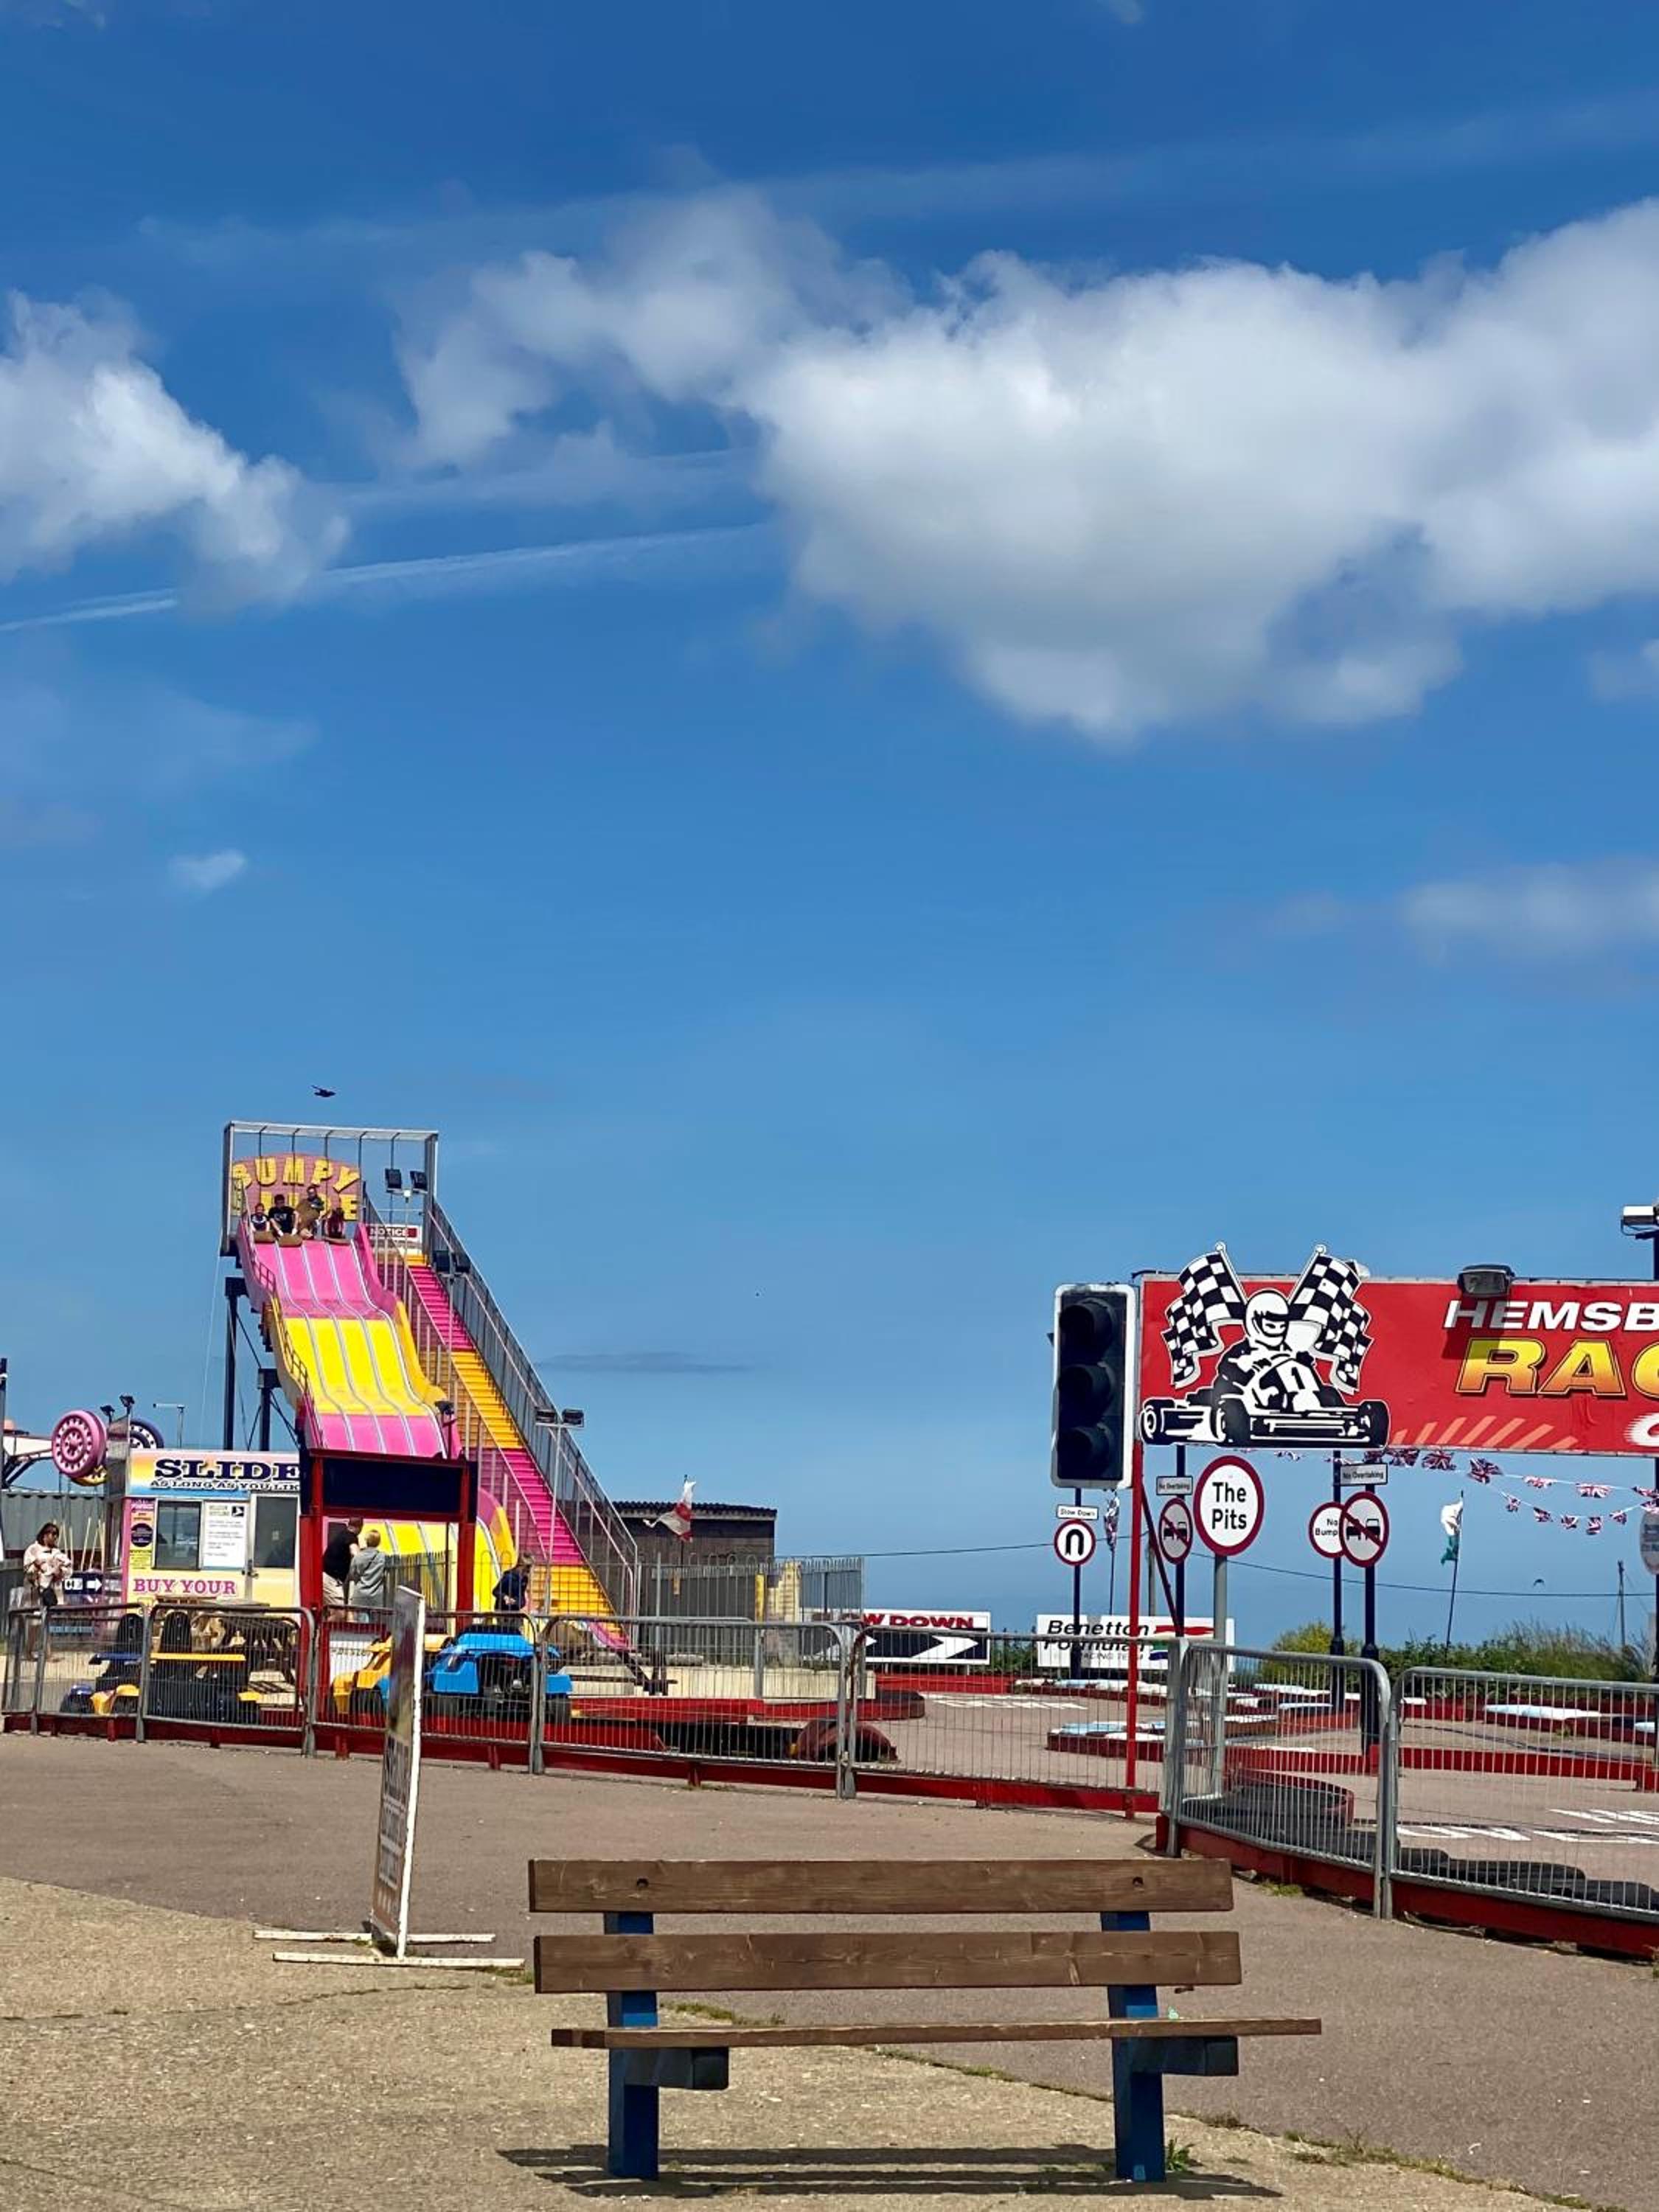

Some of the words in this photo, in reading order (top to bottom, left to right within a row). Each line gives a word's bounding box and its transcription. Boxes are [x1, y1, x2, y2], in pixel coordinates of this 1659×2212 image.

[232, 1157, 360, 1192] BUMPY
[1444, 1300, 1659, 1332] HEMSB
[155, 1458, 300, 1481] SLIDE
[240, 1482, 271, 1490] YOU
[1212, 1482, 1247, 1503] The
[1211, 1509, 1247, 1530] Pits
[1315, 1527, 1338, 1537] Bump
[133, 1579, 175, 1593] BUY
[180, 1580, 236, 1595] YOUR
[889, 1615, 974, 1629] DOWN
[1047, 1620, 1150, 1636] Benetton
